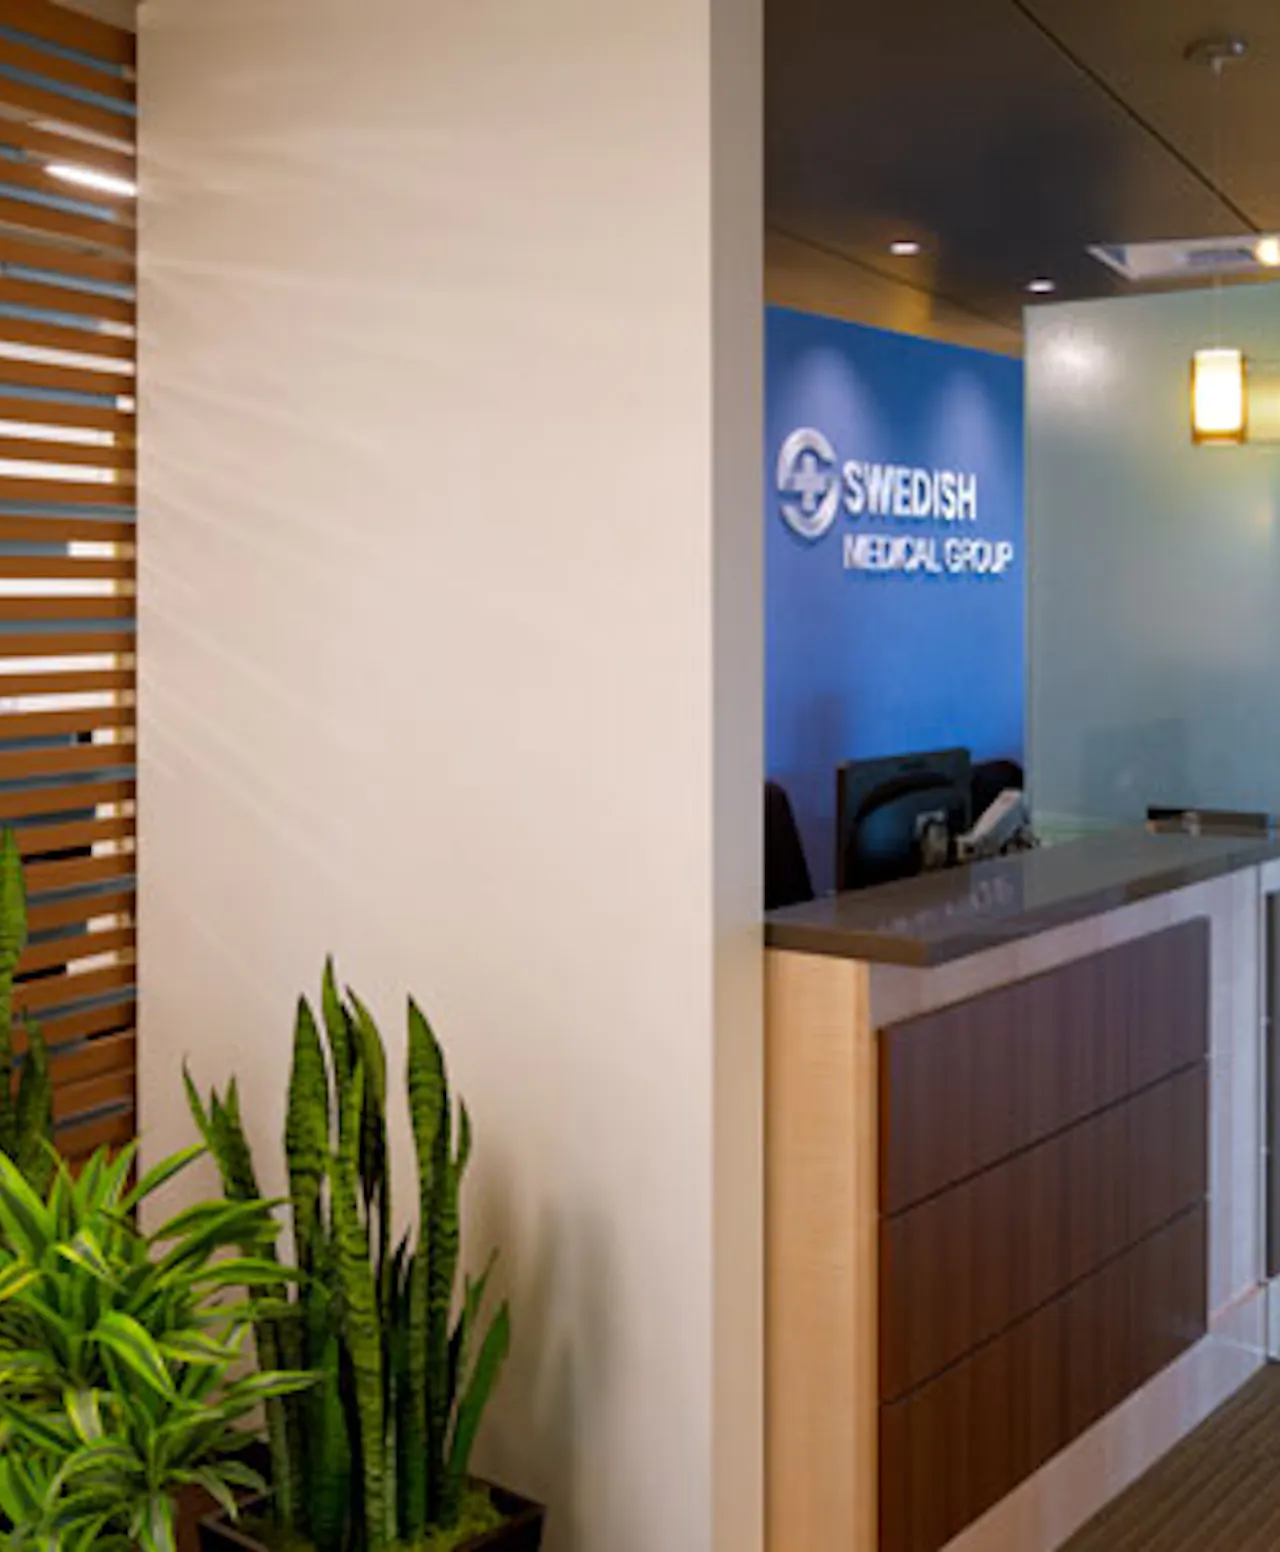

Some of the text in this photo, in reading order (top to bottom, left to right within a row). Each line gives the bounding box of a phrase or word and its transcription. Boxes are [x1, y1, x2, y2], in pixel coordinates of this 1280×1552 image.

[843, 460, 977, 520] SWEDISH
[843, 533, 1014, 574] MEDICAL GROUP
